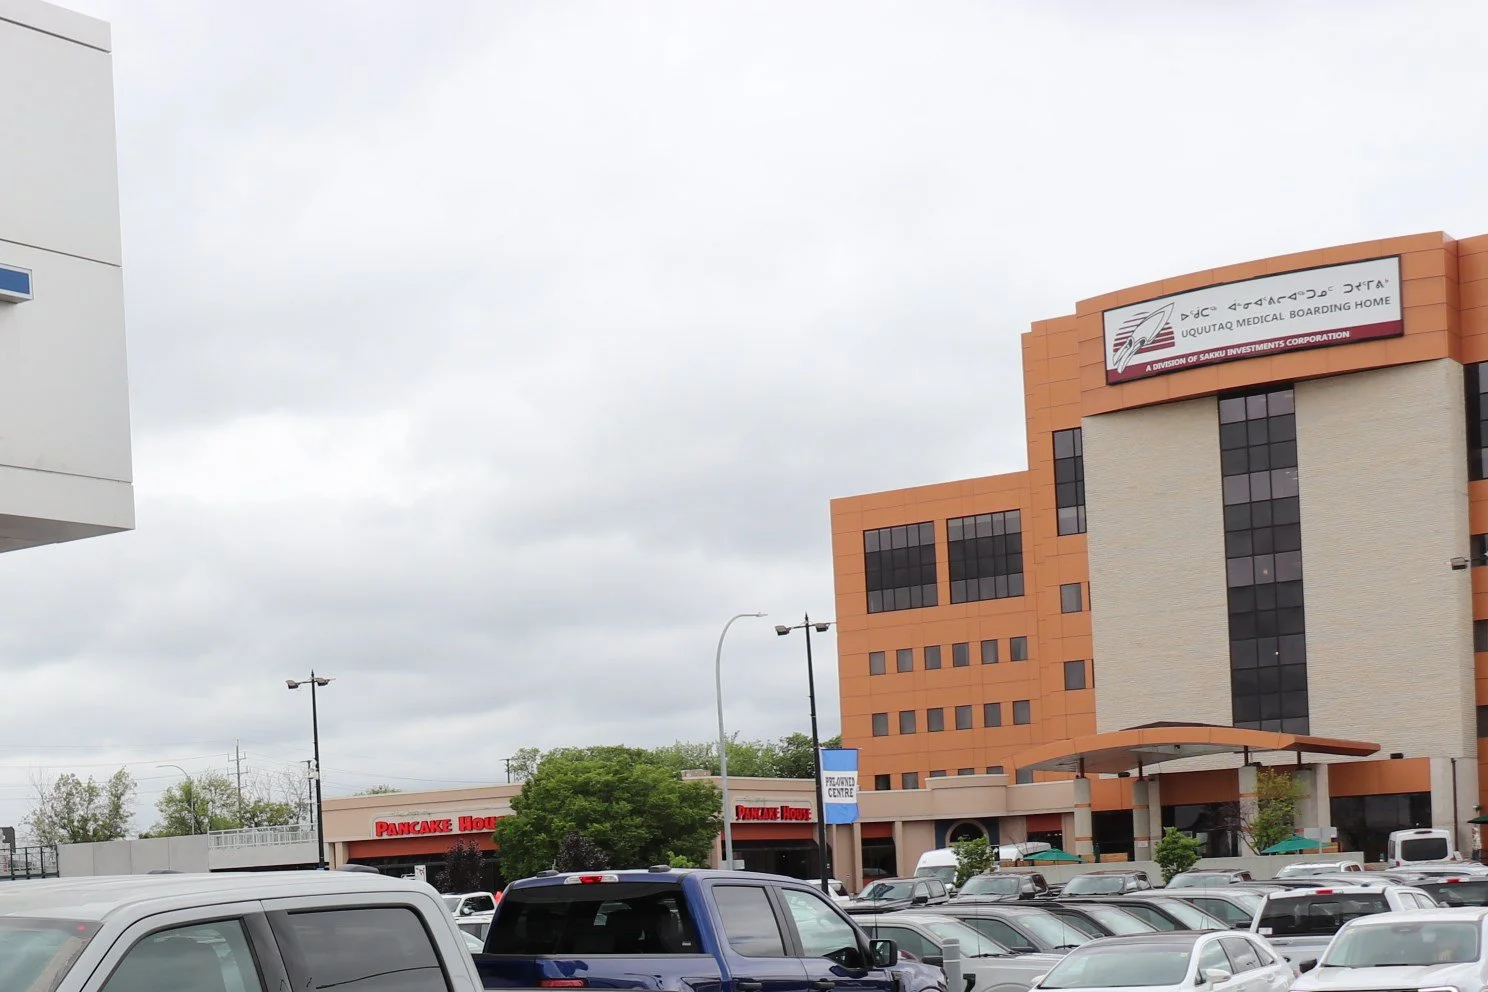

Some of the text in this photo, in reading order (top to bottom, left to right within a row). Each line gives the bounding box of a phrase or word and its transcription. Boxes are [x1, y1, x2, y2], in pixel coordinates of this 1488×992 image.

[1181, 296, 1392, 338] UQUUTAQ MEDICAL BOARDING HOME
[1145, 330, 1351, 372] A DIVISION OF SAKKU INVESTMENTS CORPORATION
[827, 788, 854, 798] CENTRE
[735, 804, 812, 821] PANCAKE HOUSE
[375, 815, 505, 837] PANCAKE HOU
